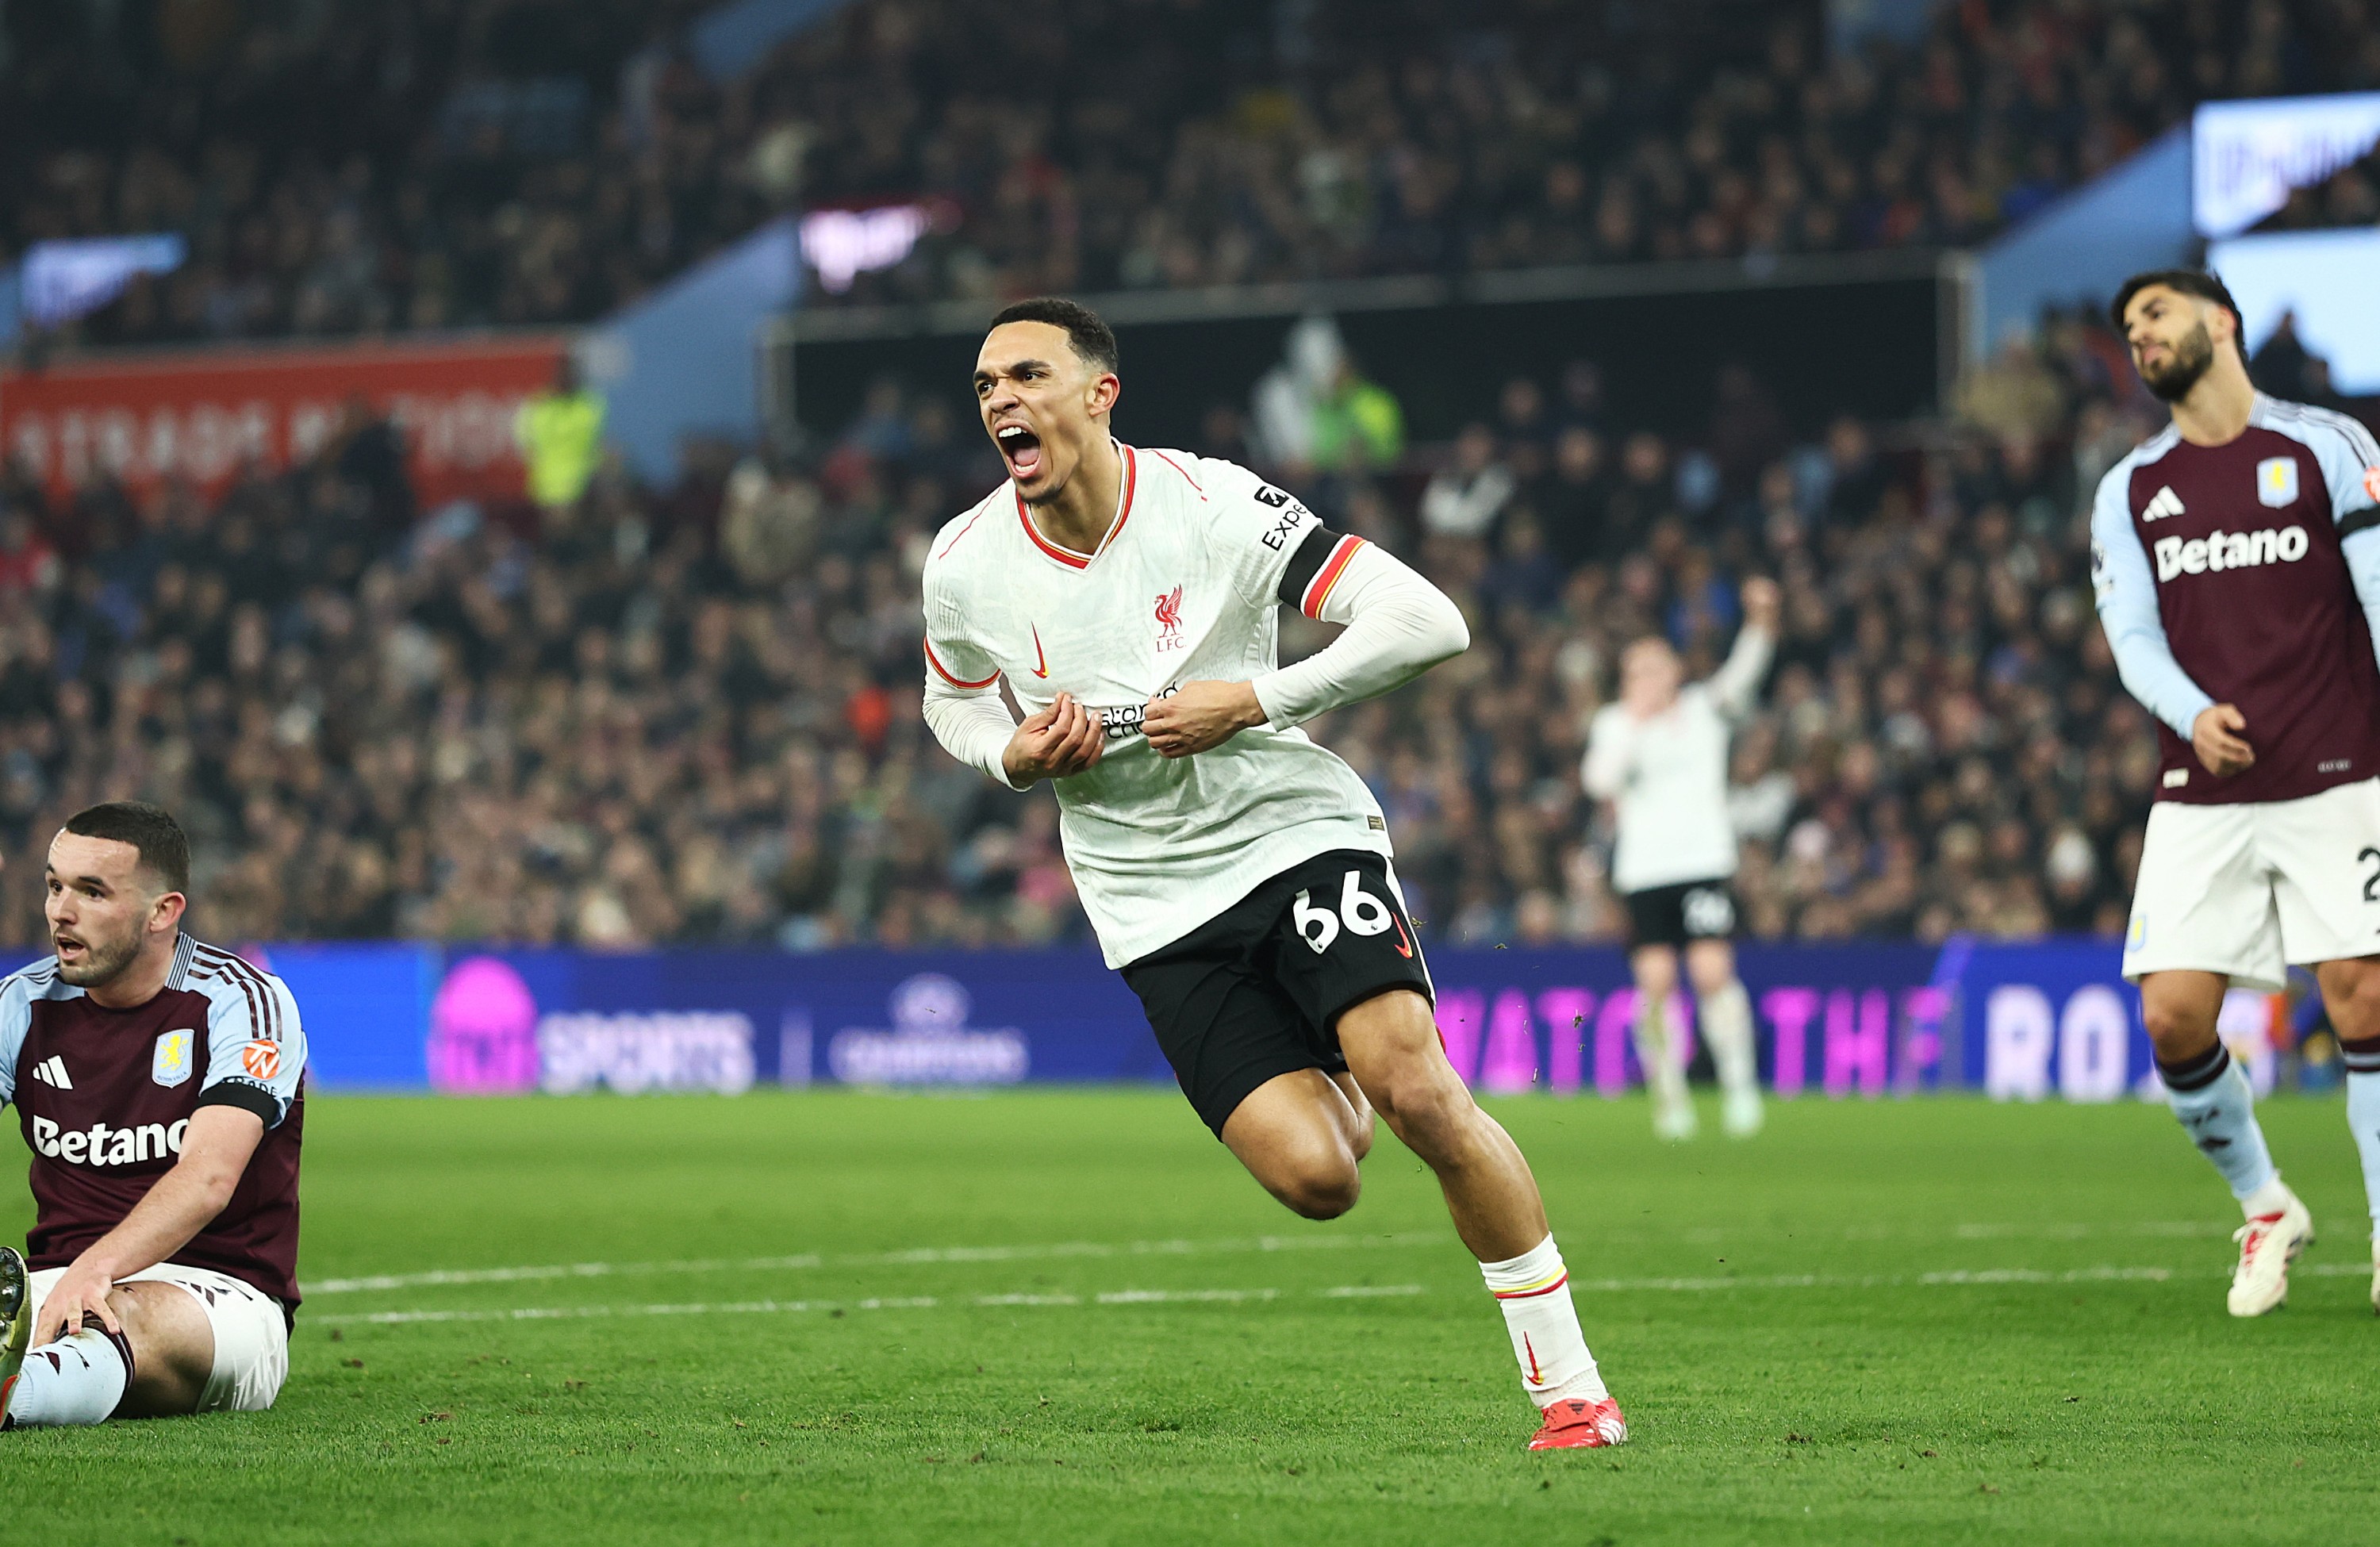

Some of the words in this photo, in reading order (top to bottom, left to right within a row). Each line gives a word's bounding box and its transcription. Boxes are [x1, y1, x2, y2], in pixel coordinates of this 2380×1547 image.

[2153, 525, 2309, 584] Betano
[1293, 870, 1392, 954] 66
[223, 1076, 278, 1098] RADE
